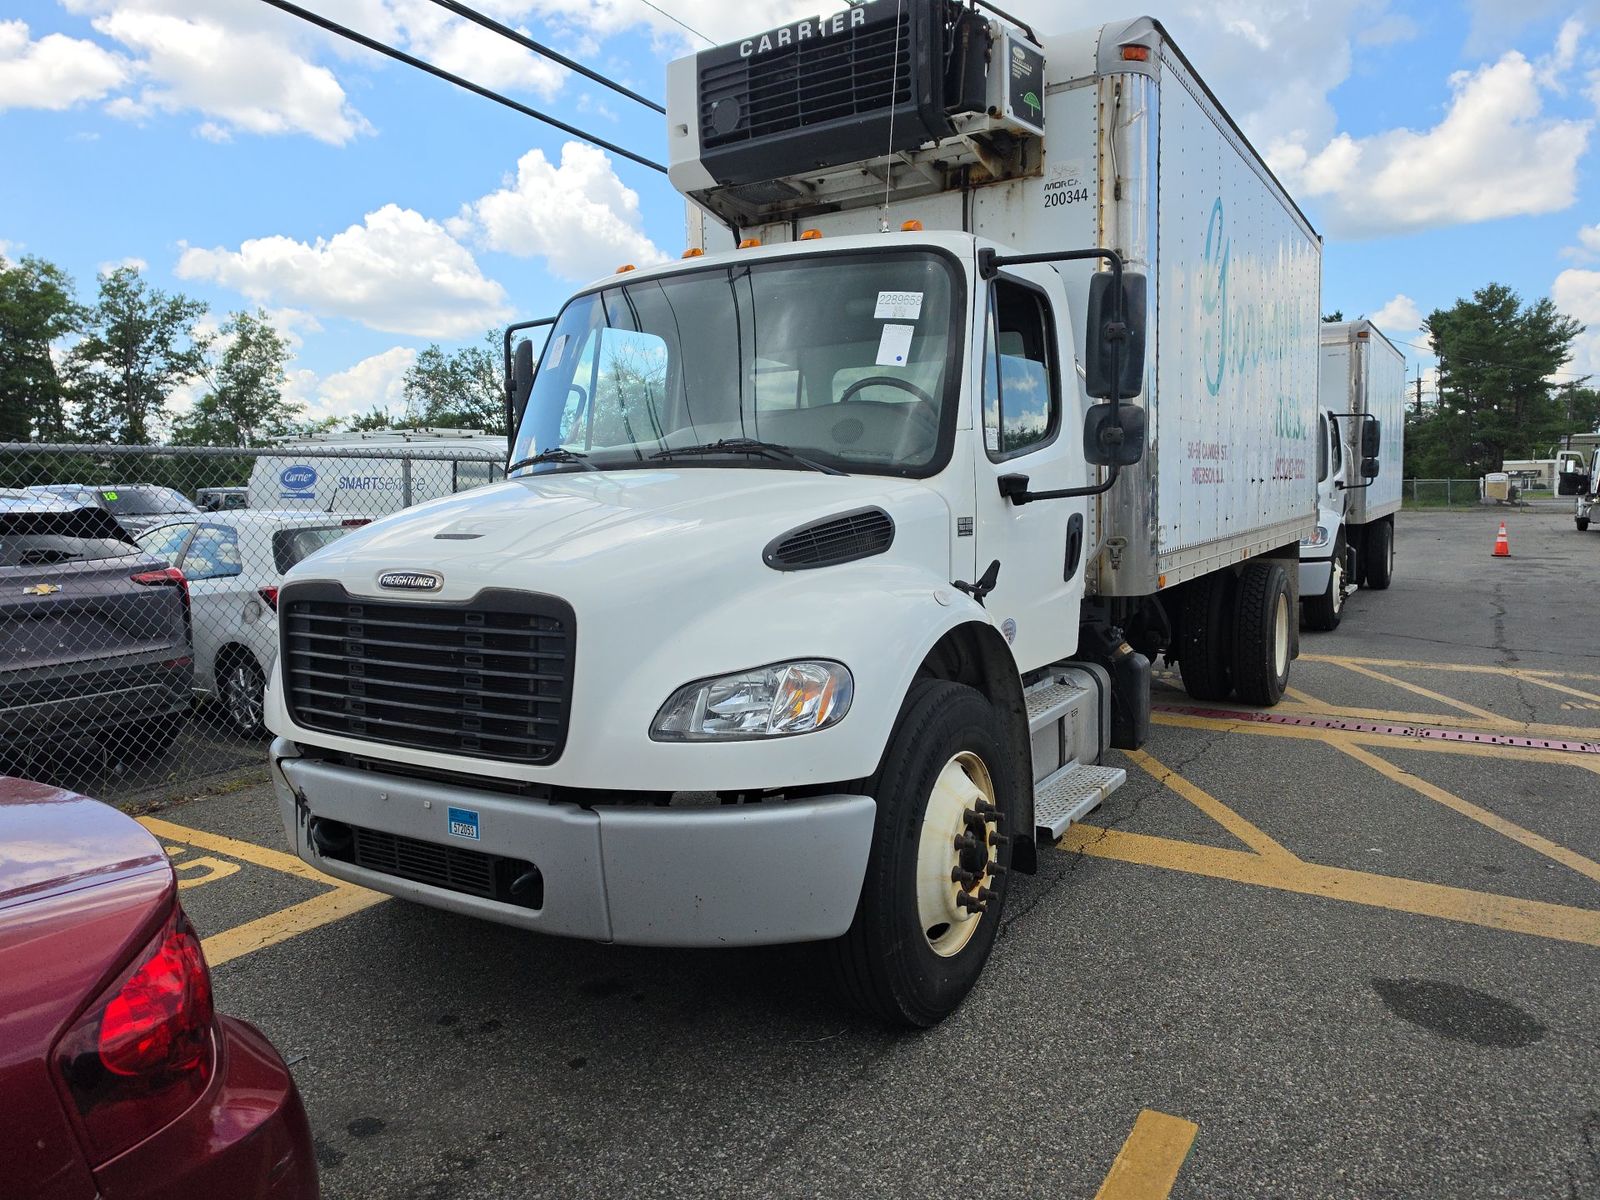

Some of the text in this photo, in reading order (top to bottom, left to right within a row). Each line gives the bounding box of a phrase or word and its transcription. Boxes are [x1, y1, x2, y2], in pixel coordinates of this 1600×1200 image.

[740, 7, 865, 57] CARRIER
[1044, 188, 1088, 208] 200344
[284, 471, 313, 482] Carrier
[382, 575, 435, 587] FREIGHTLINER
[453, 822, 475, 837] 572053
